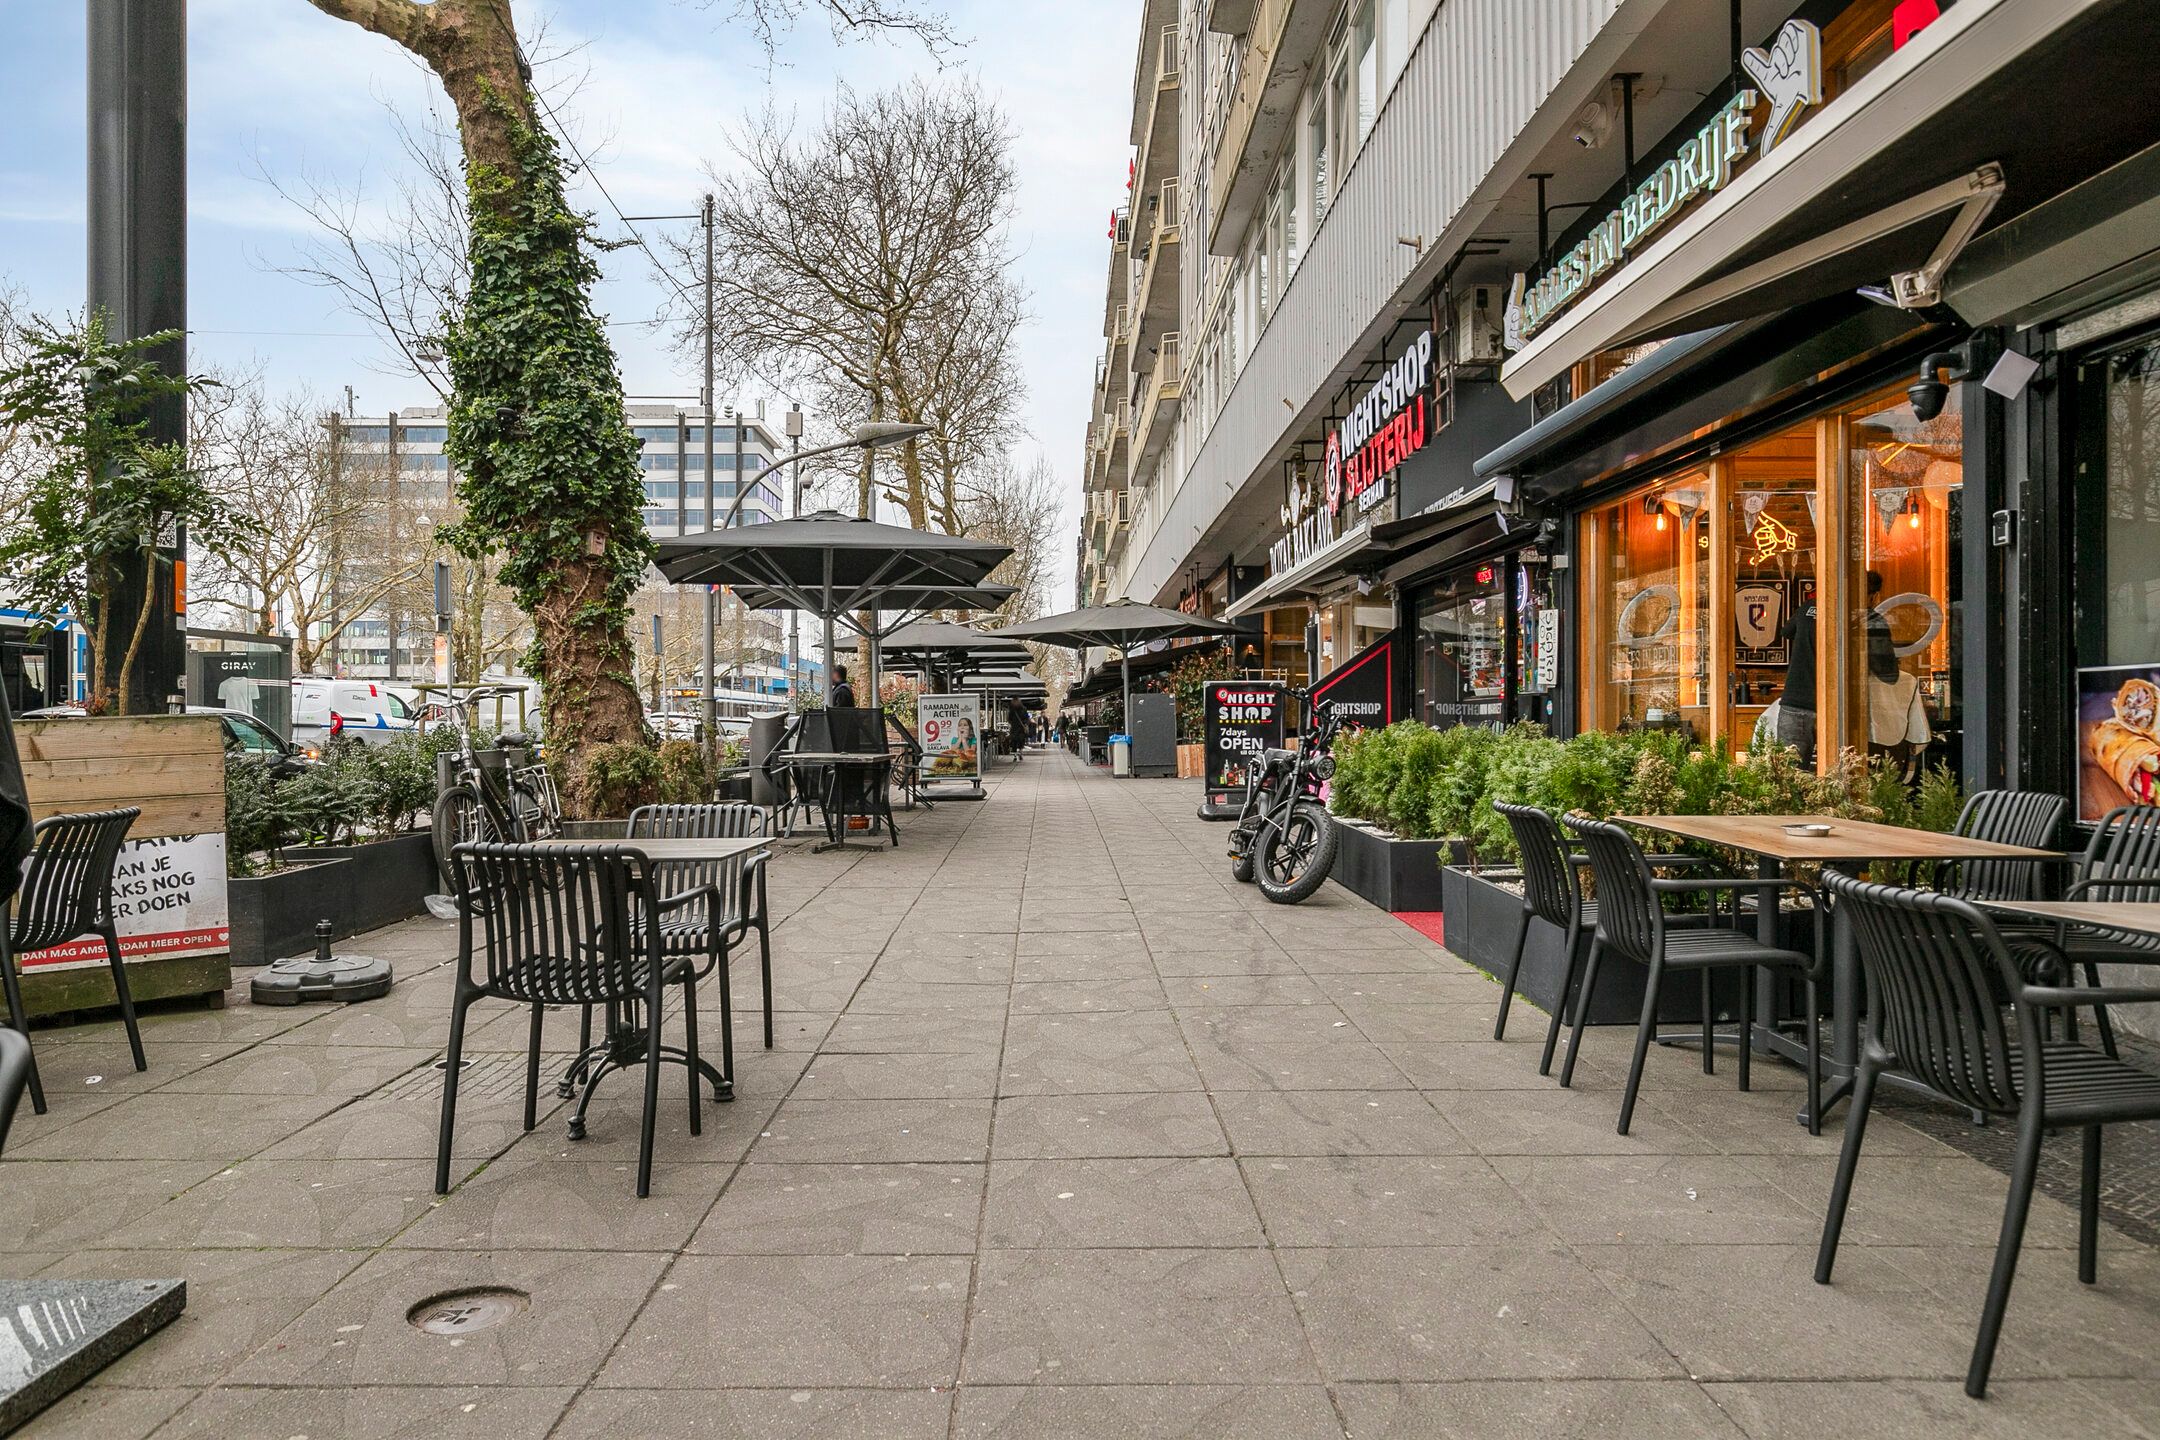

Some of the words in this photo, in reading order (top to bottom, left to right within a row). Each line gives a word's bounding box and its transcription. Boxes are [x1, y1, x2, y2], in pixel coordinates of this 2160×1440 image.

[1588, 210, 1623, 277] IN
[1621, 89, 1756, 250] BEDRIJF
[1341, 330, 1431, 461] NIGHTSHOP
[1346, 394, 1424, 501] SLIJTERIJ
[1269, 533, 1292, 577] ROYAL
[1293, 502, 1334, 564] BAKLAVA
[221, 661, 256, 670] GIRAV
[1227, 694, 1275, 704] NIGHT
[1330, 703, 1381, 715] IGHTSHOP
[1219, 706, 1272, 720] SHOP
[925, 720, 939, 742] 9
[1220, 727, 1247, 738] 7days
[1220, 738, 1264, 750] OPEN
[112, 861, 145, 880] AN
[151, 856, 172, 872] JE
[152, 871, 196, 892] NOG
[138, 891, 192, 915] DOEN
[21, 950, 48, 962] DAN
[50, 948, 77, 958] MAG
[79, 940, 149, 955] AMSTRDAM
[151, 937, 181, 948] MEER
[182, 934, 212, 946] OPEN
